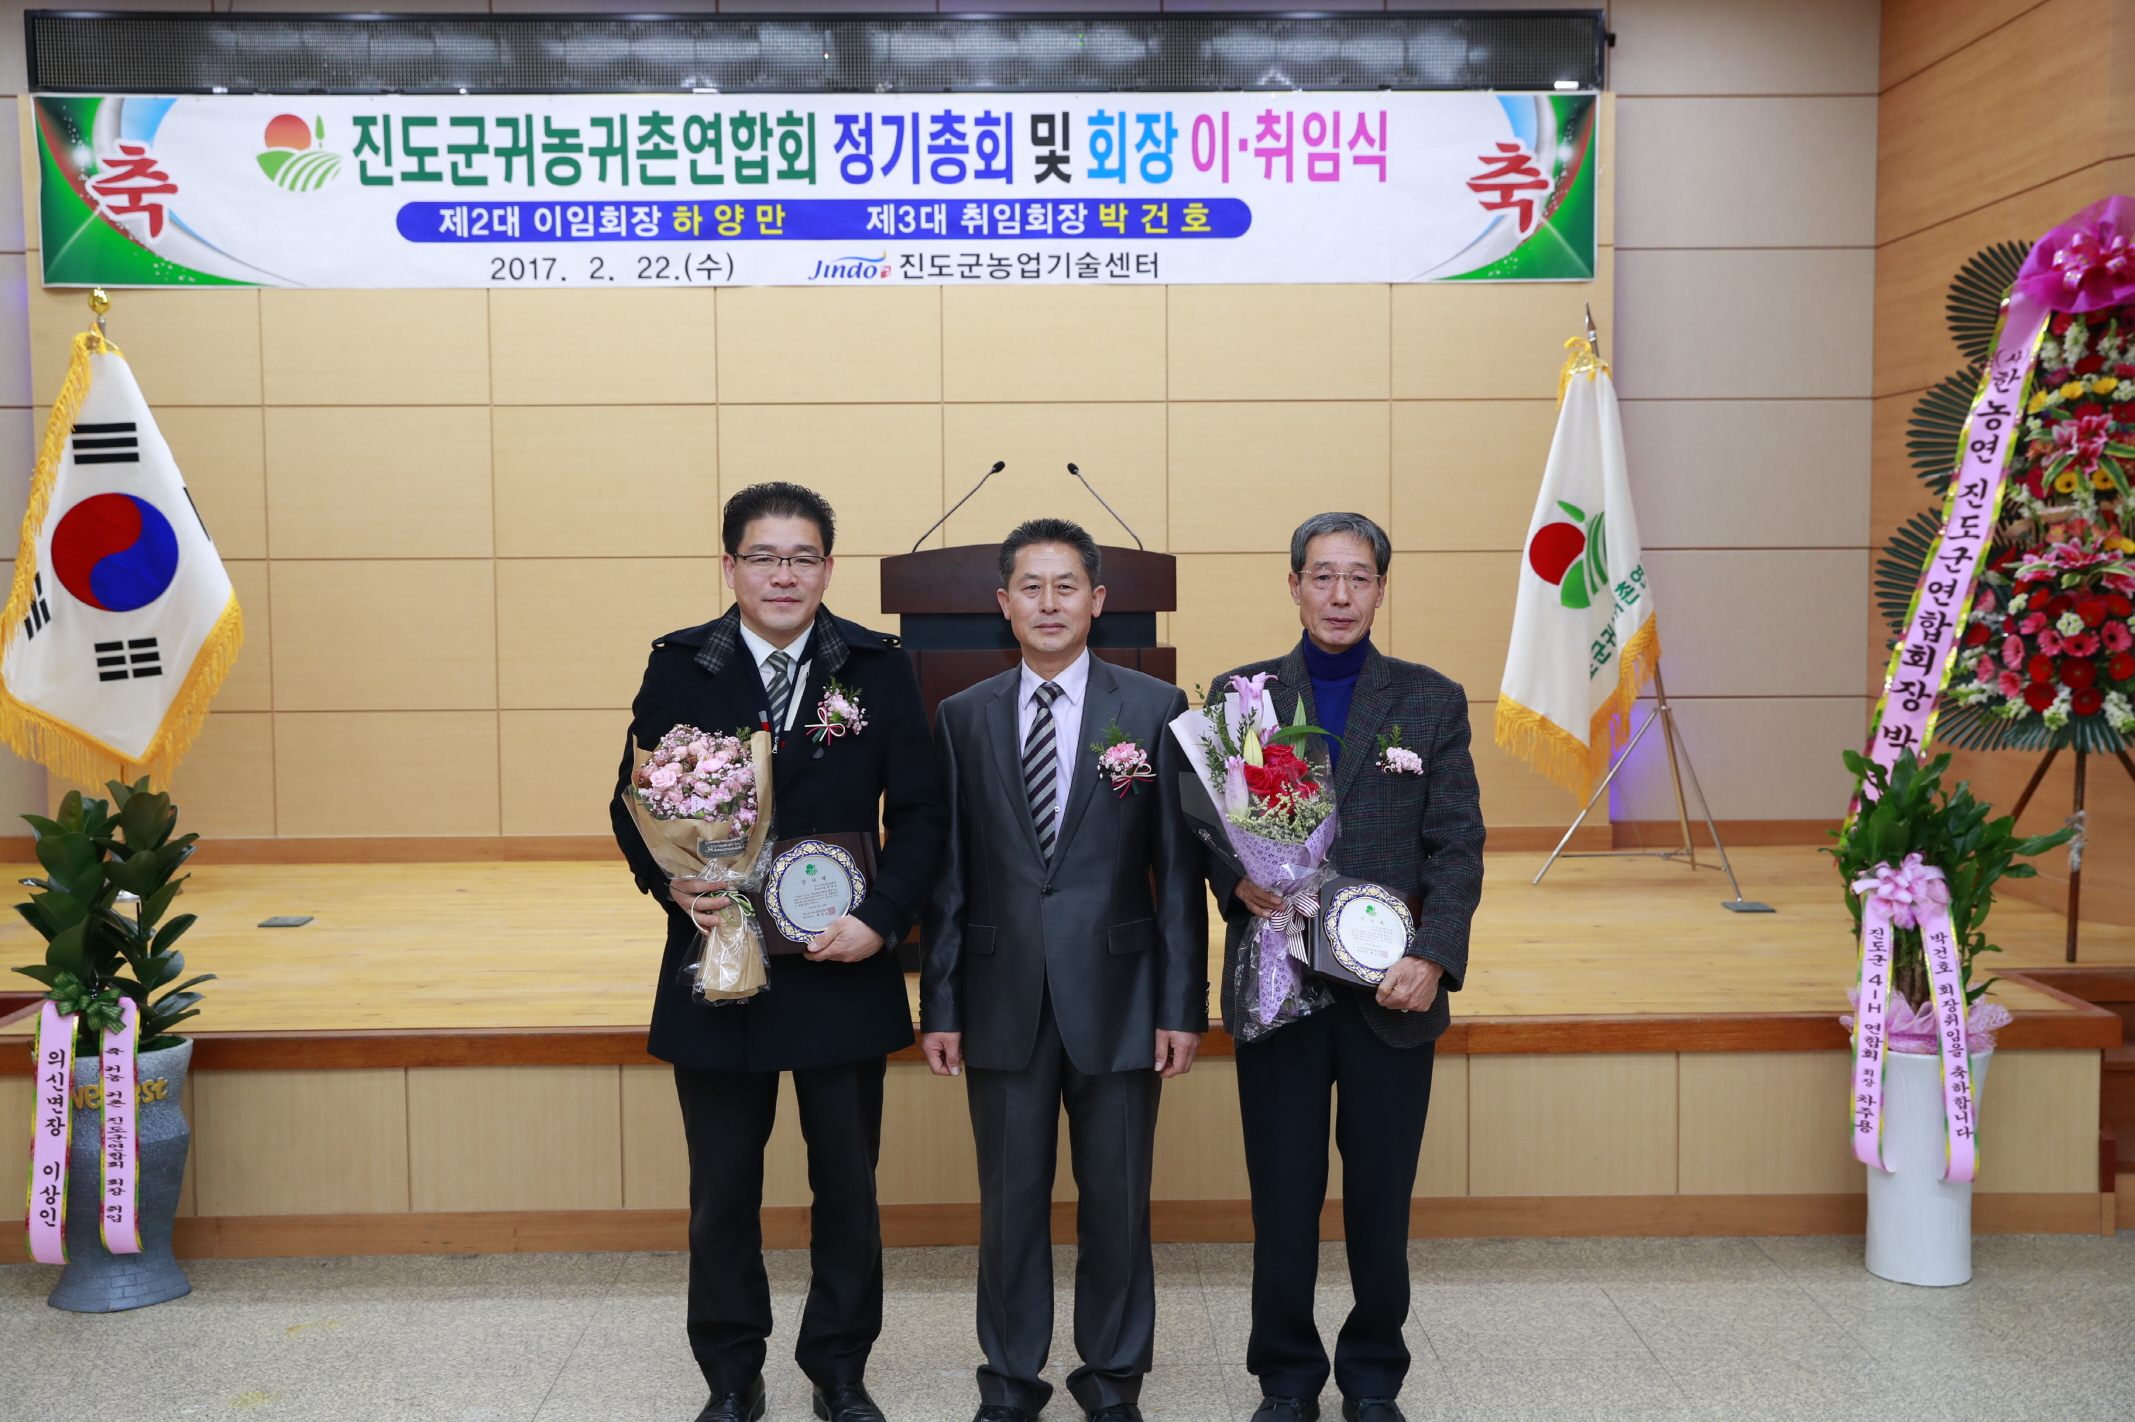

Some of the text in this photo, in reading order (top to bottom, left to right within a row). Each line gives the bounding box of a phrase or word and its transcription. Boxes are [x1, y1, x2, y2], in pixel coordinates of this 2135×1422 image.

[352, 110, 816, 187] 진도군귀농귀촌연합회
[833, 109, 1014, 185] 정기총회
[1030, 111, 1072, 184] 및
[1087, 109, 1178, 184] 회장
[91, 143, 179, 239] 축
[1465, 141, 1550, 234] 축
[439, 206, 520, 238] 제2대
[534, 205, 662, 237] 이임회장
[866, 203, 947, 235] 제3대
[960, 202, 1088, 235] 취임회장
[491, 257, 566, 281] 2017.
[590, 257, 614, 281] 2.
[899, 252, 1160, 280] 진도군농업기술센터
[1868, 927, 1887, 966] 진도군
[1862, 1022, 1884, 1062] 연합회
[1929, 931, 1953, 974] 박건호
[1950, 1064, 1974, 1139] 축하합니다
[39, 1049, 66, 1228] 의신면장 이상인
